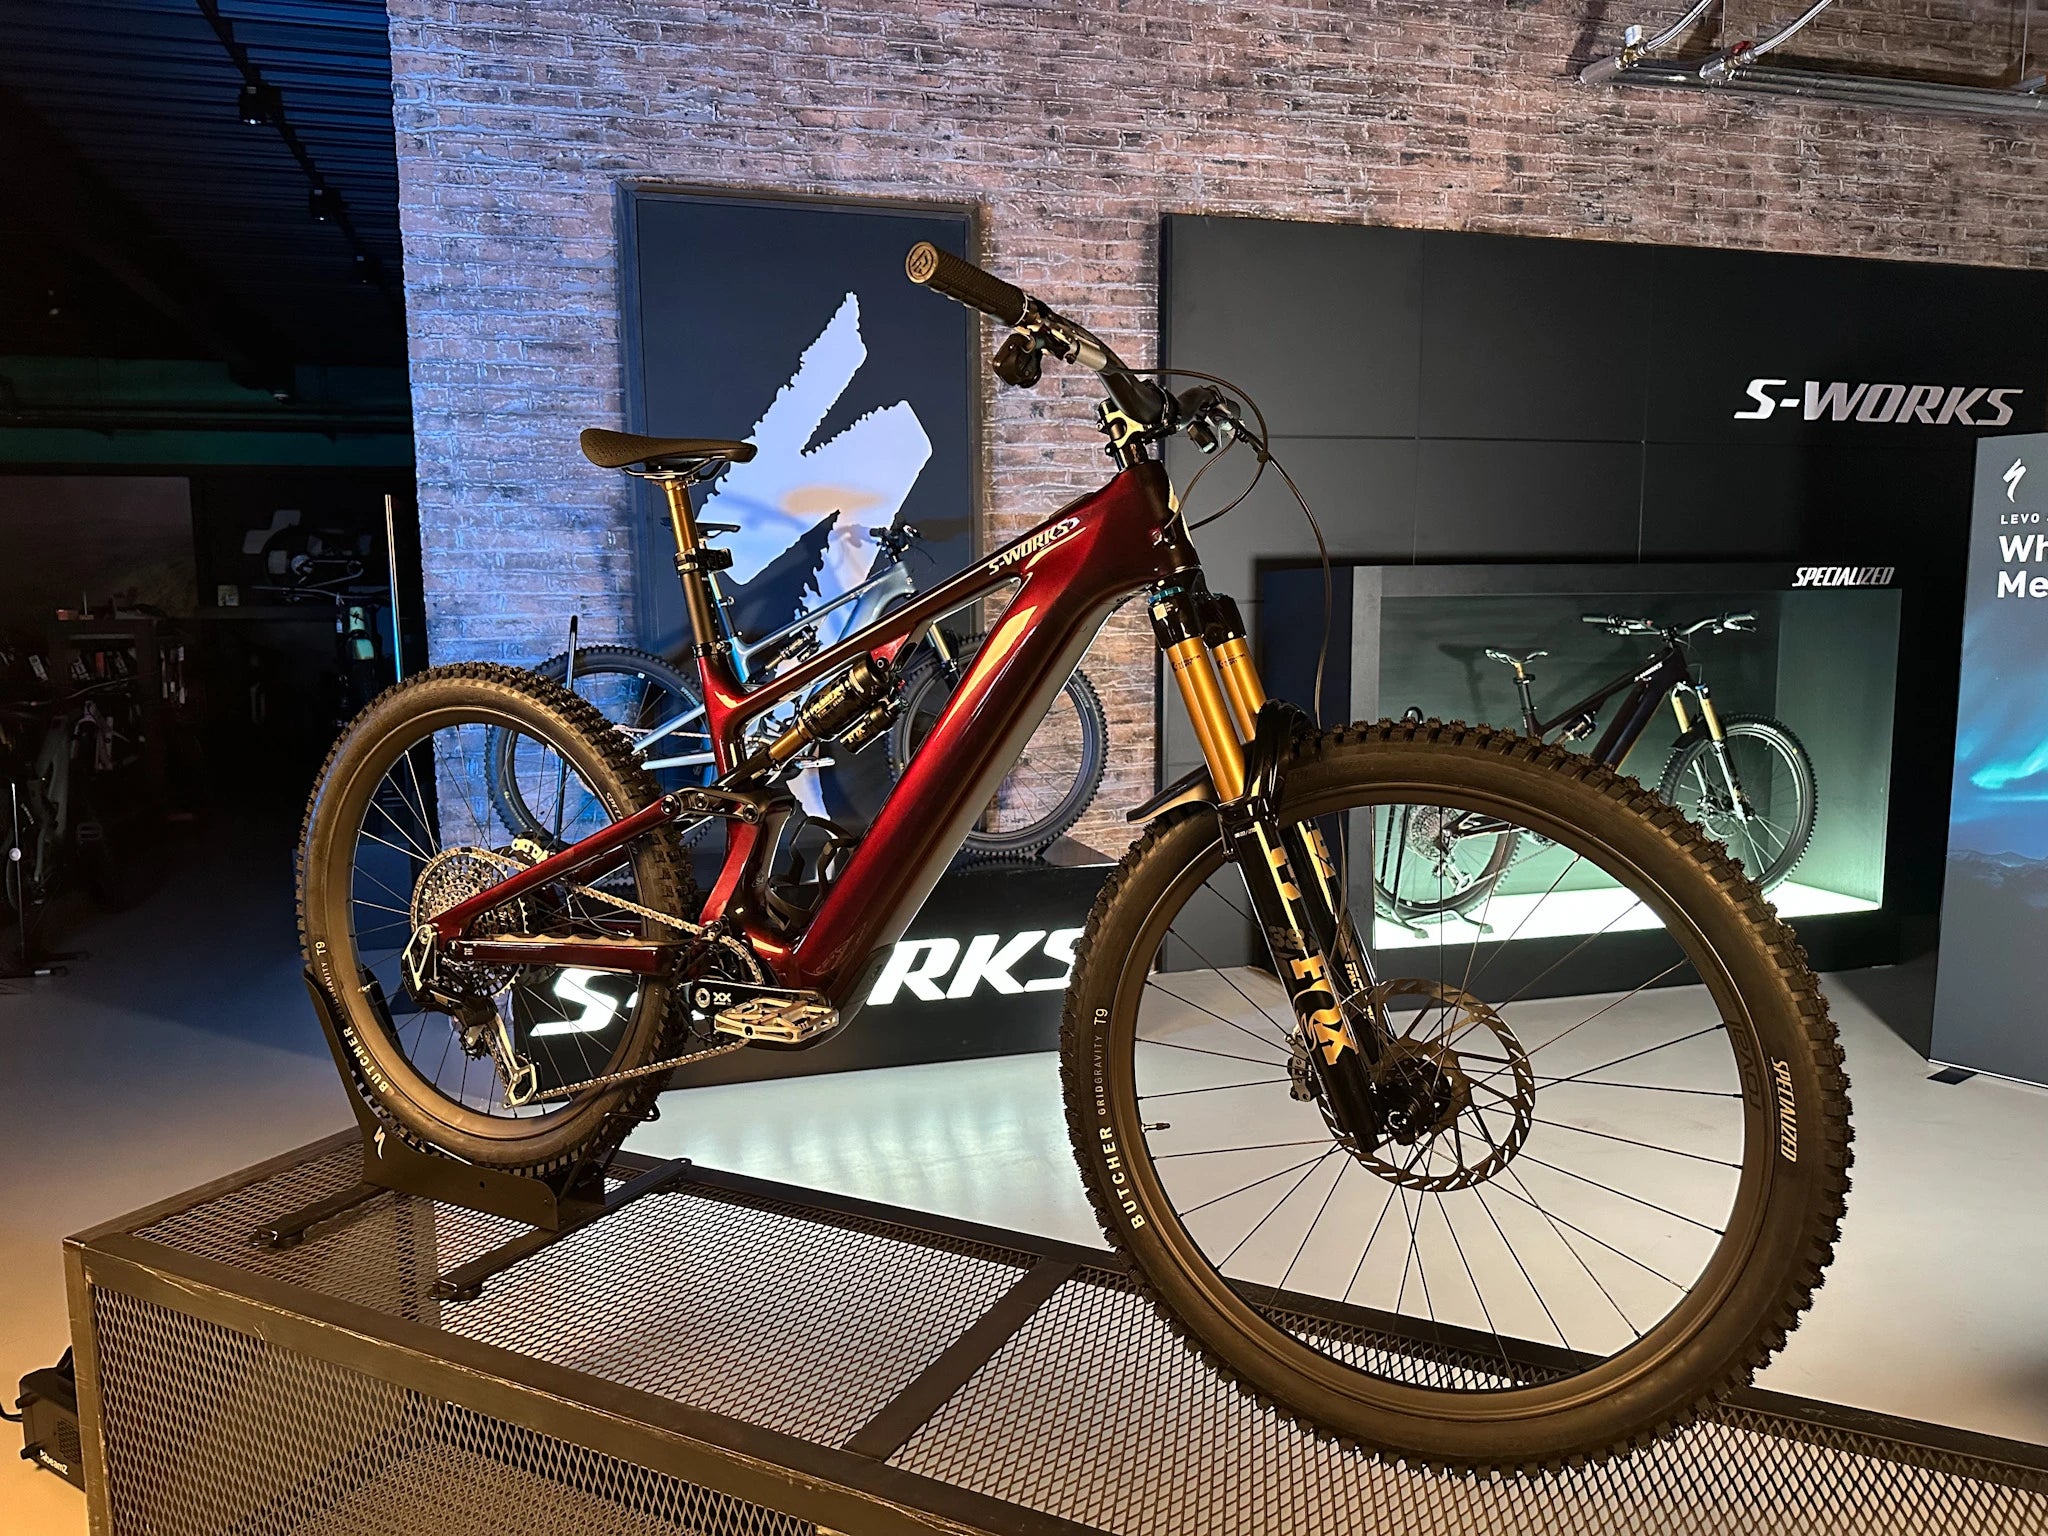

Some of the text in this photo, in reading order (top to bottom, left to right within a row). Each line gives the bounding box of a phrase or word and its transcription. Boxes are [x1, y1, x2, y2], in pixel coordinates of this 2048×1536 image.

[1733, 378, 2024, 426] S-WORKS
[2000, 513, 2040, 525] LEVO
[988, 517, 1080, 576] S-WORKS
[1791, 566, 1895, 588] SPECIALIZED
[1997, 570, 2048, 598] Me
[314, 941, 327, 956] T9
[713, 992, 732, 1003] XX
[1290, 952, 1359, 1066] FOX
[342, 1026, 390, 1093] BUTCHER
[1093, 1008, 1146, 1230] BUTCHER GRIDGRAVITY T9
[1770, 1056, 1798, 1163] SPECIALIZED
